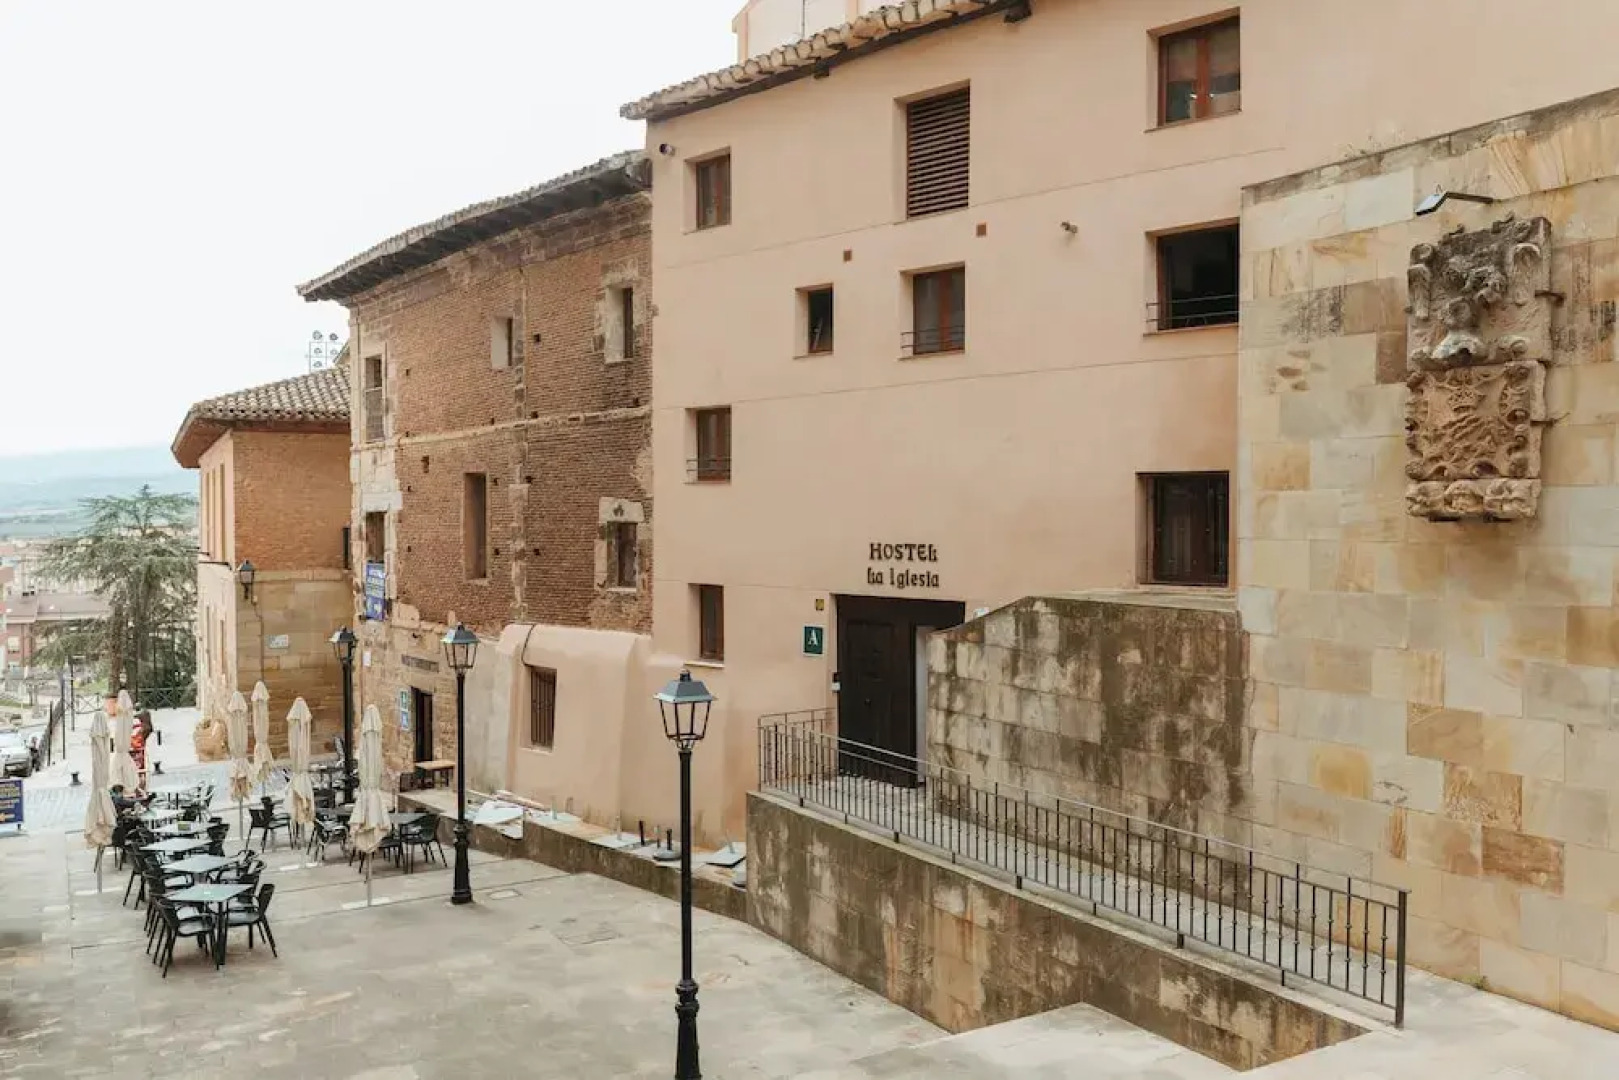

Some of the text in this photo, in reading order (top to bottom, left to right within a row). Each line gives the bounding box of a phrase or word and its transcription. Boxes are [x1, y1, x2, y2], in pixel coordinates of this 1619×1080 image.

[869, 543, 938, 562] HOSTEL
[867, 567, 940, 589] La Iglesia
[808, 629, 819, 646] A
